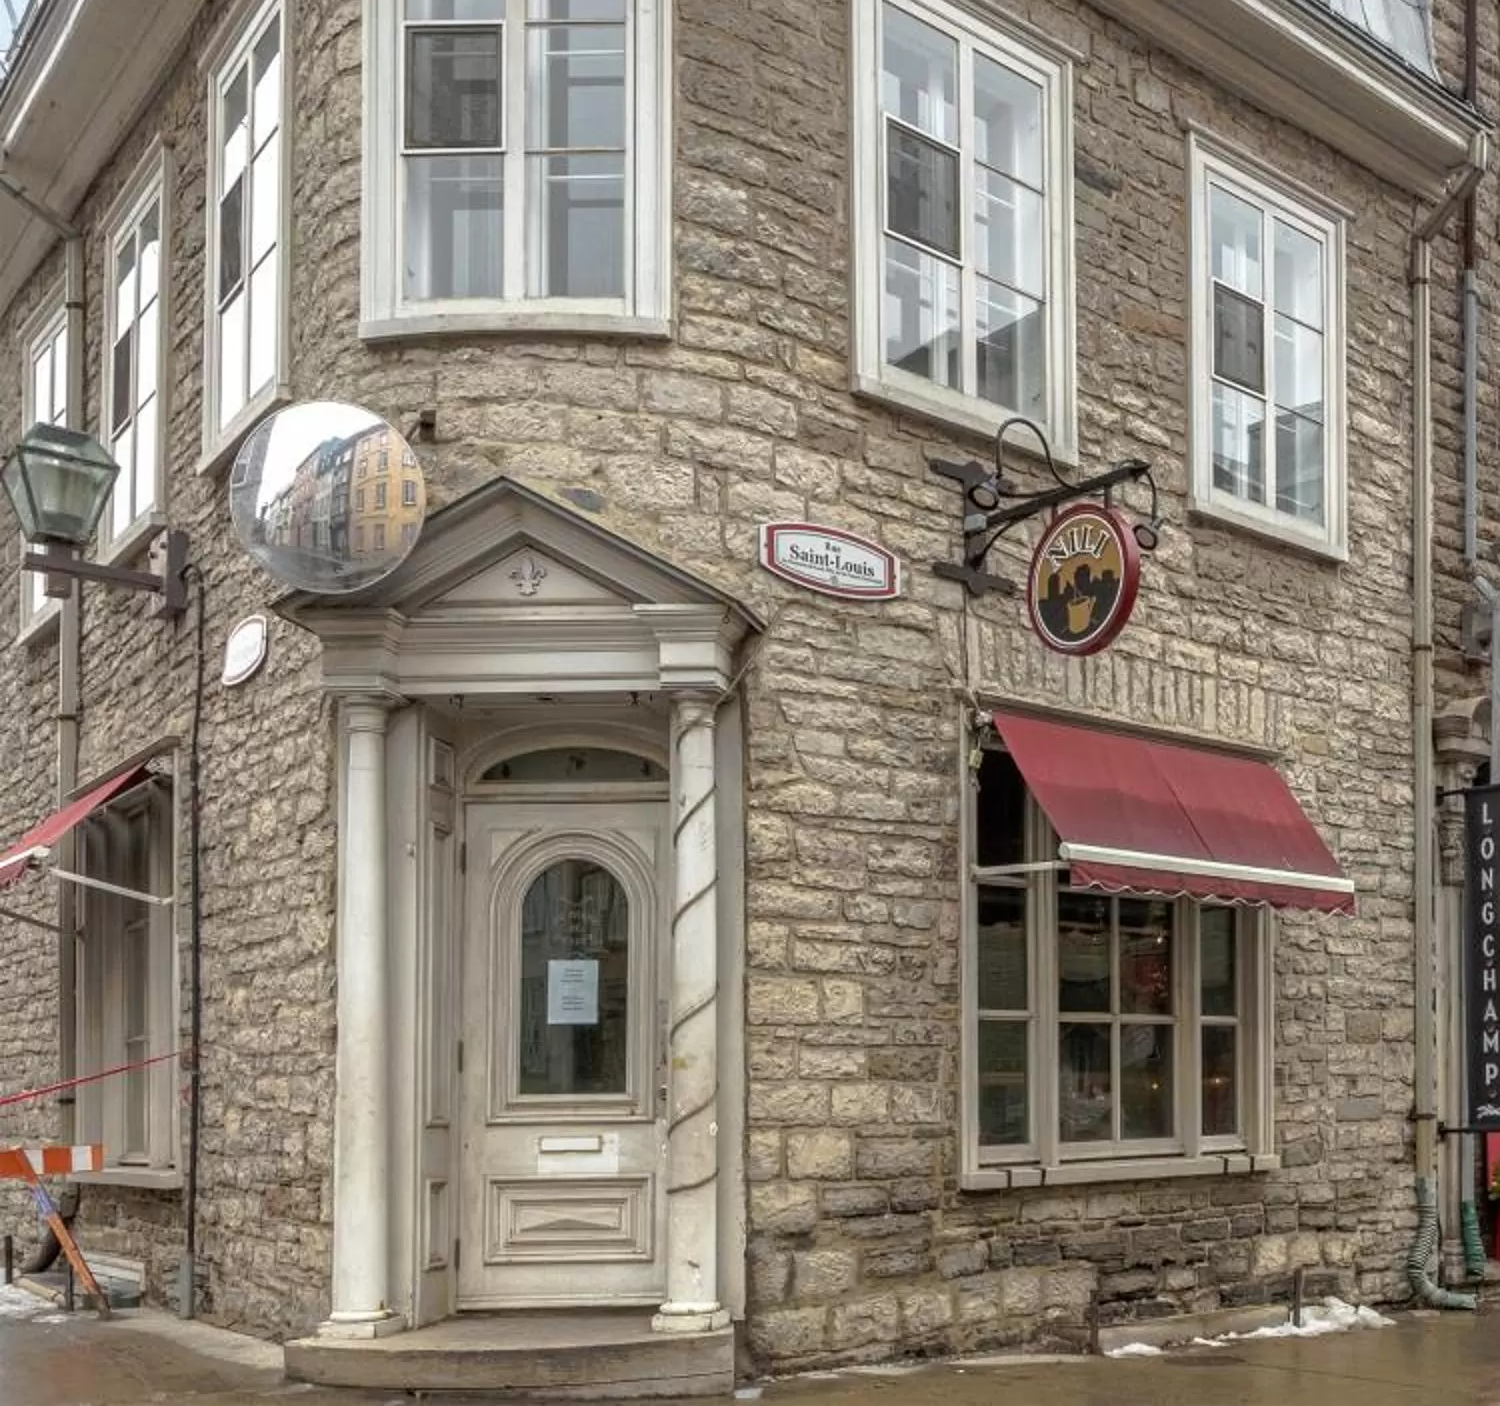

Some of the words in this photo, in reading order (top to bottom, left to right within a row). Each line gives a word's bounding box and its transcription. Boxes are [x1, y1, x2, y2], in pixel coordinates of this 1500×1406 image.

[789, 543, 875, 577] Saint-Louis
[1045, 524, 1110, 573] NILI
[1481, 802, 1499, 1086] LONGCHAMP
